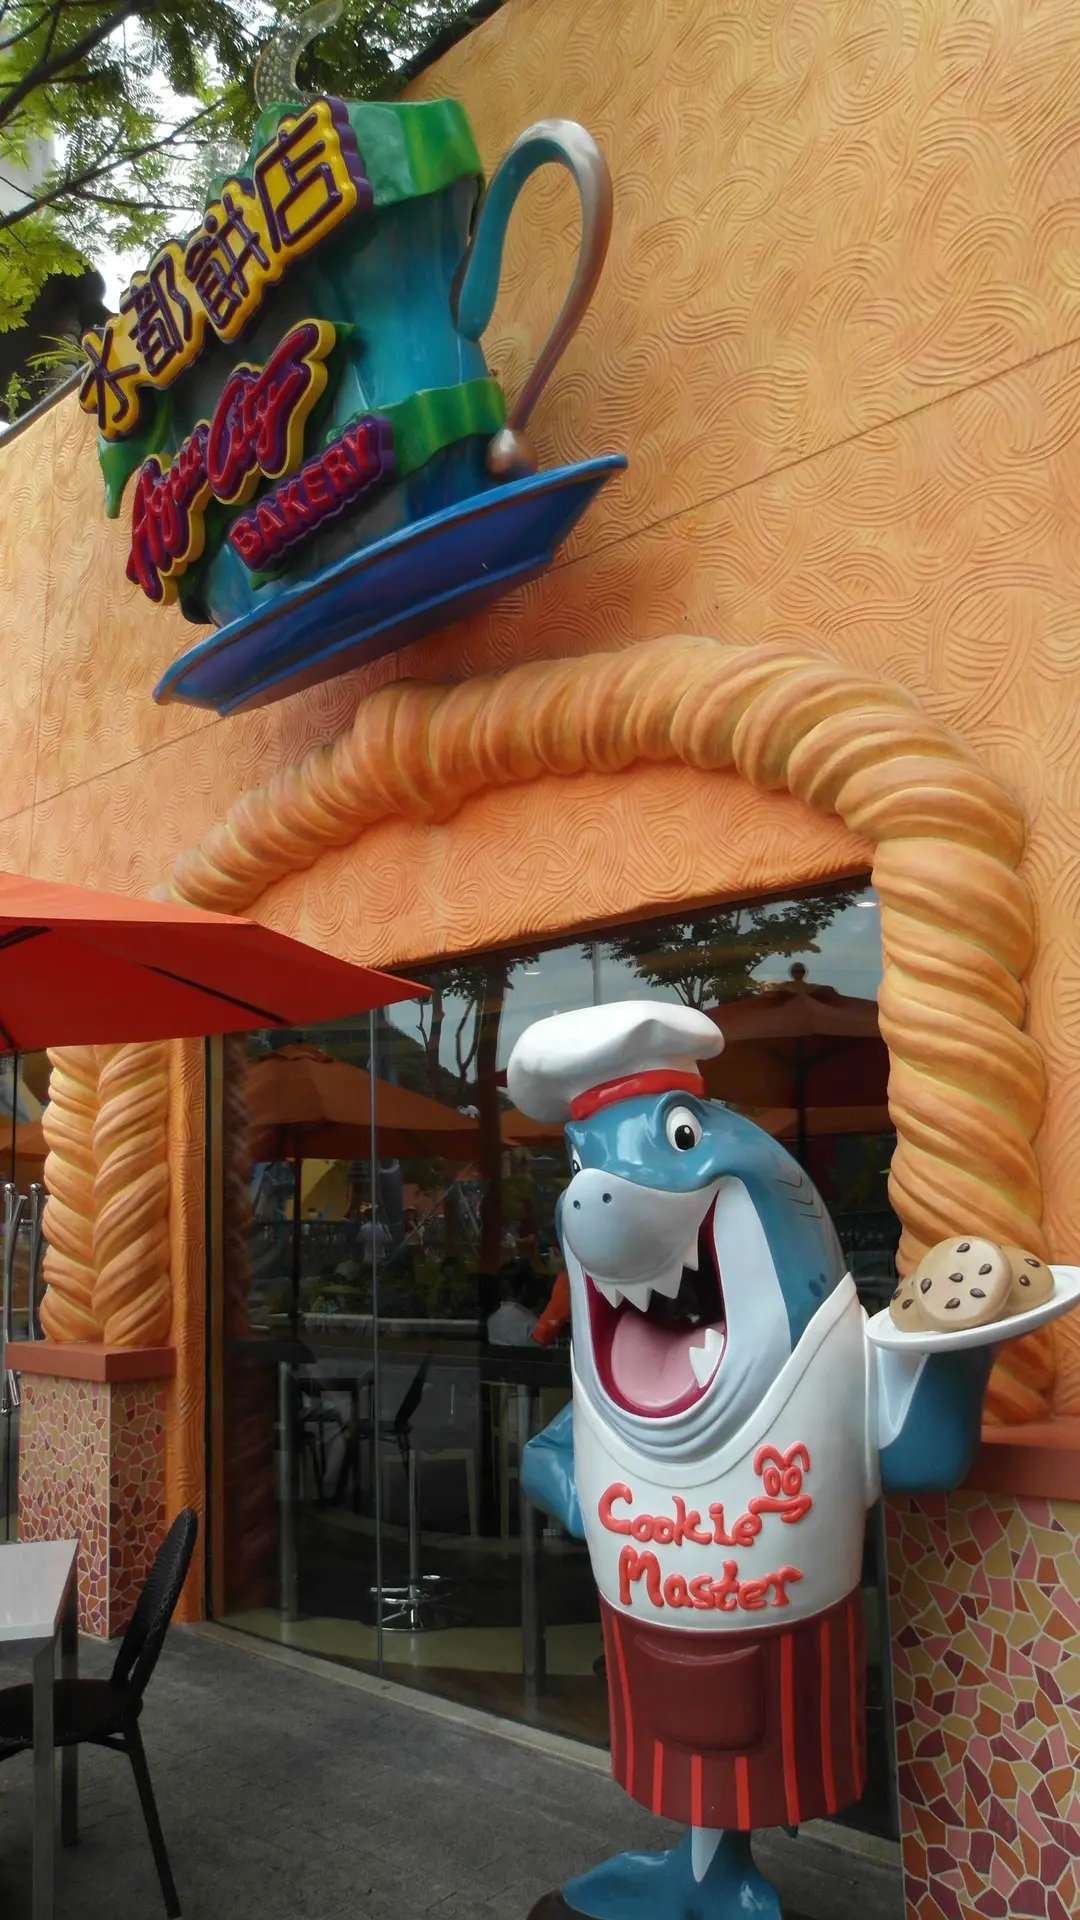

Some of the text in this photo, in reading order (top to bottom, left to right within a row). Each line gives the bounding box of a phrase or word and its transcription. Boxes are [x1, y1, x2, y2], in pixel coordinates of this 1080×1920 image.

[79, 112, 343, 430] 水都餅店
[126, 331, 305, 597] Aqua City
[229, 426, 369, 562] BAKERY
[598, 1482, 763, 1547] Cookie
[618, 1544, 804, 1611] Master
